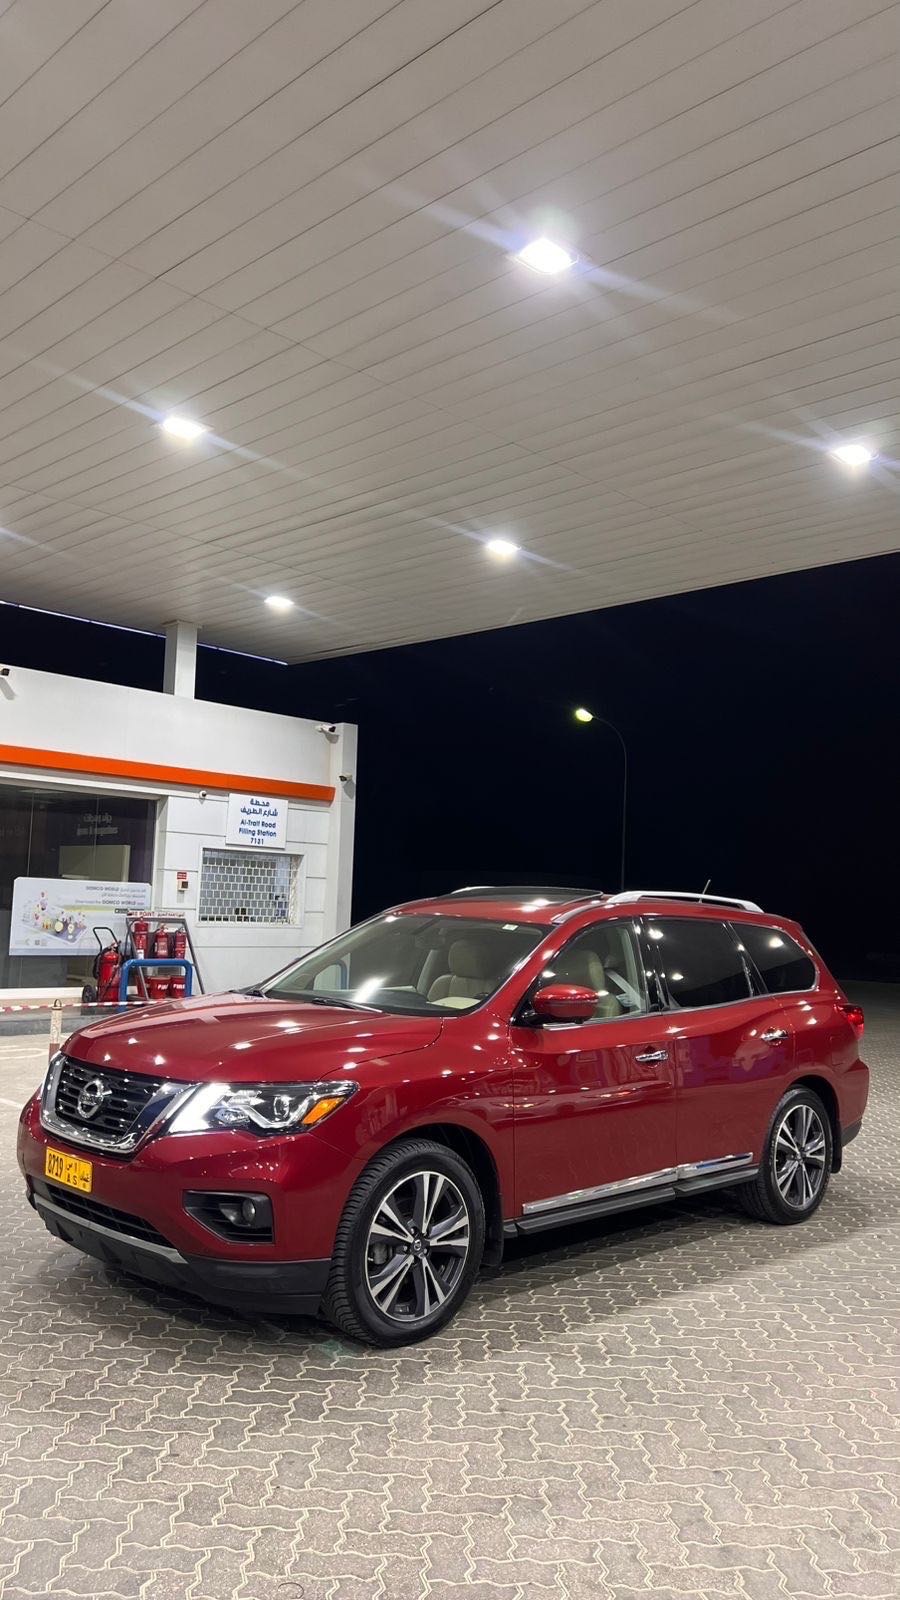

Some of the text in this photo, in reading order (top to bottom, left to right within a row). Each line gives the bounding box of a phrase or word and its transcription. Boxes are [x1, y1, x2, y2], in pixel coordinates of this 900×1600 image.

[250, 798, 270, 807] محطة
[263, 808, 278, 817] شارع
[239, 827, 277, 837] Filling Station
